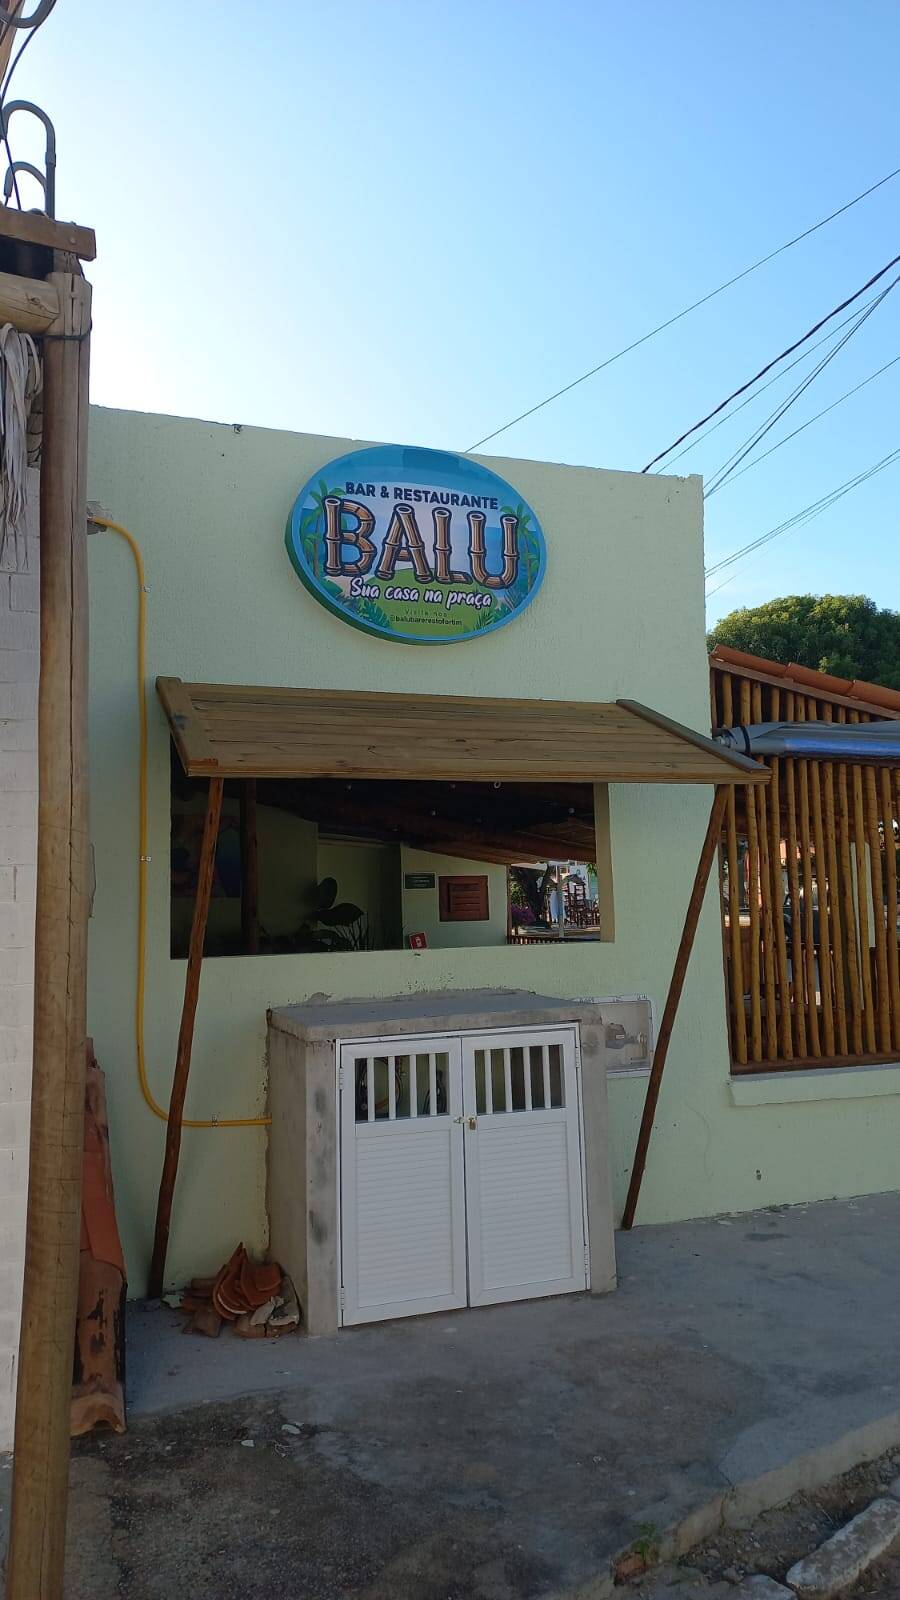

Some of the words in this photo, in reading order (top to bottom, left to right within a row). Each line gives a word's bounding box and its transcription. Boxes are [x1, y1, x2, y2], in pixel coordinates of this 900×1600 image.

[345, 482, 376, 498] BAR
[380, 486, 390, 499] &
[393, 487, 499, 510] RESTAURANTE
[323, 495, 521, 591] BALU
[350, 577, 381, 599] Sua
[384, 586, 419, 602] casa
[423, 589, 443, 604] na
[446, 589, 493, 610] praça
